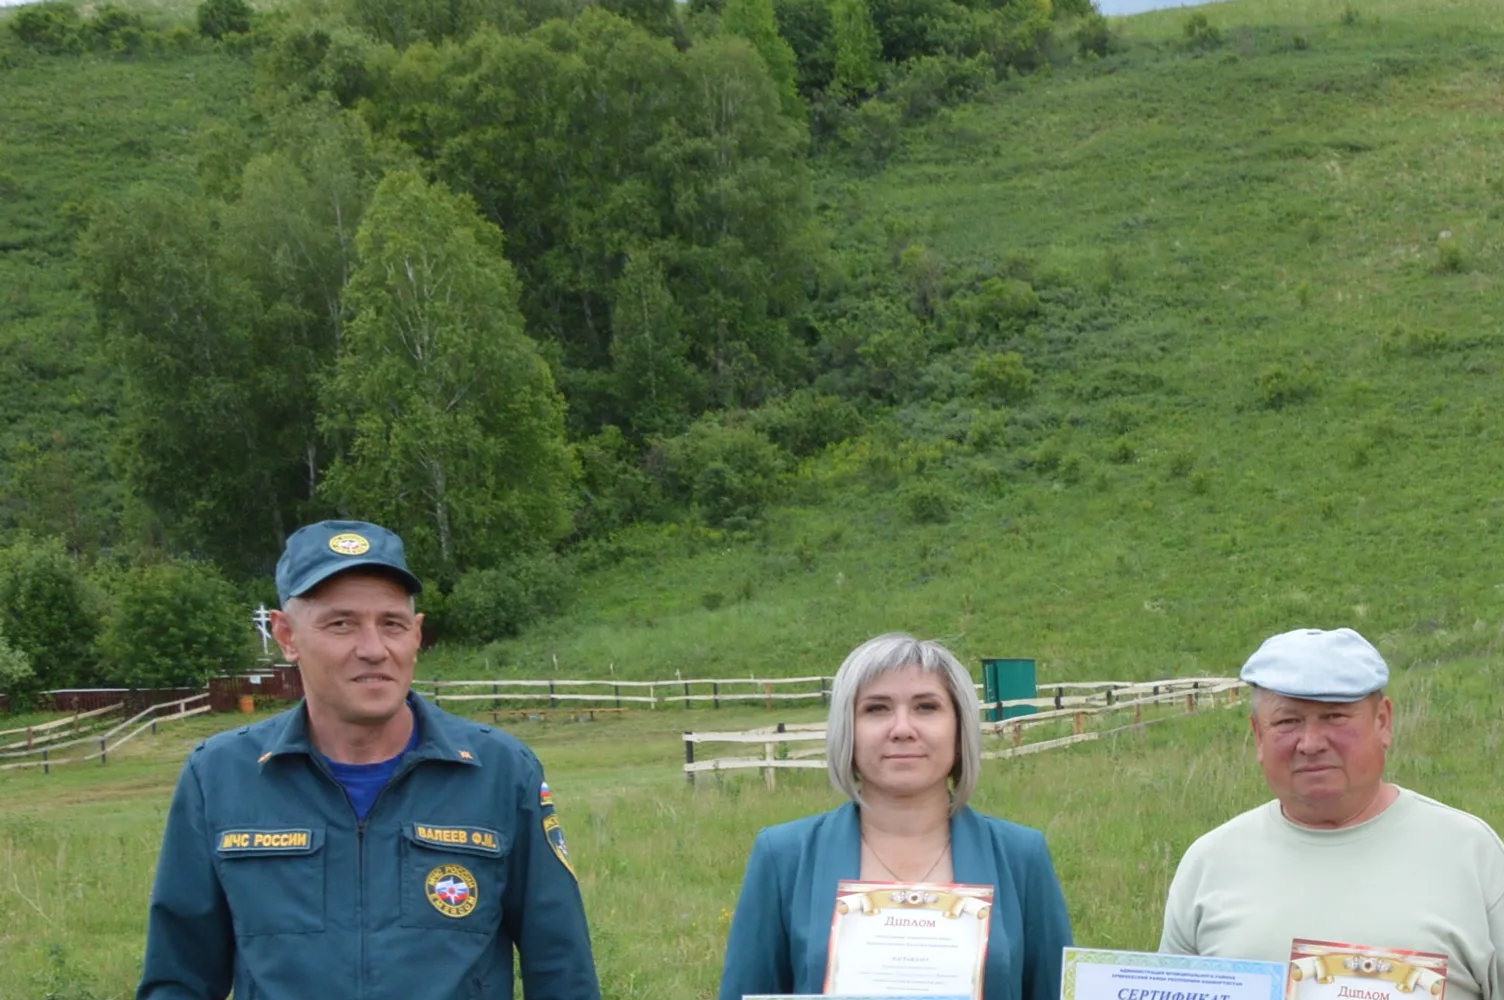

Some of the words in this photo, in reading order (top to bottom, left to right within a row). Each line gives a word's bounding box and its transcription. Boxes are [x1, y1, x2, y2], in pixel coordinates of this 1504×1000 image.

[223, 833, 250, 848] МЧС
[254, 832, 308, 847] РОССИИ
[417, 826, 467, 843] ВАЛЕЕВ
[884, 915, 936, 928] Диплом
